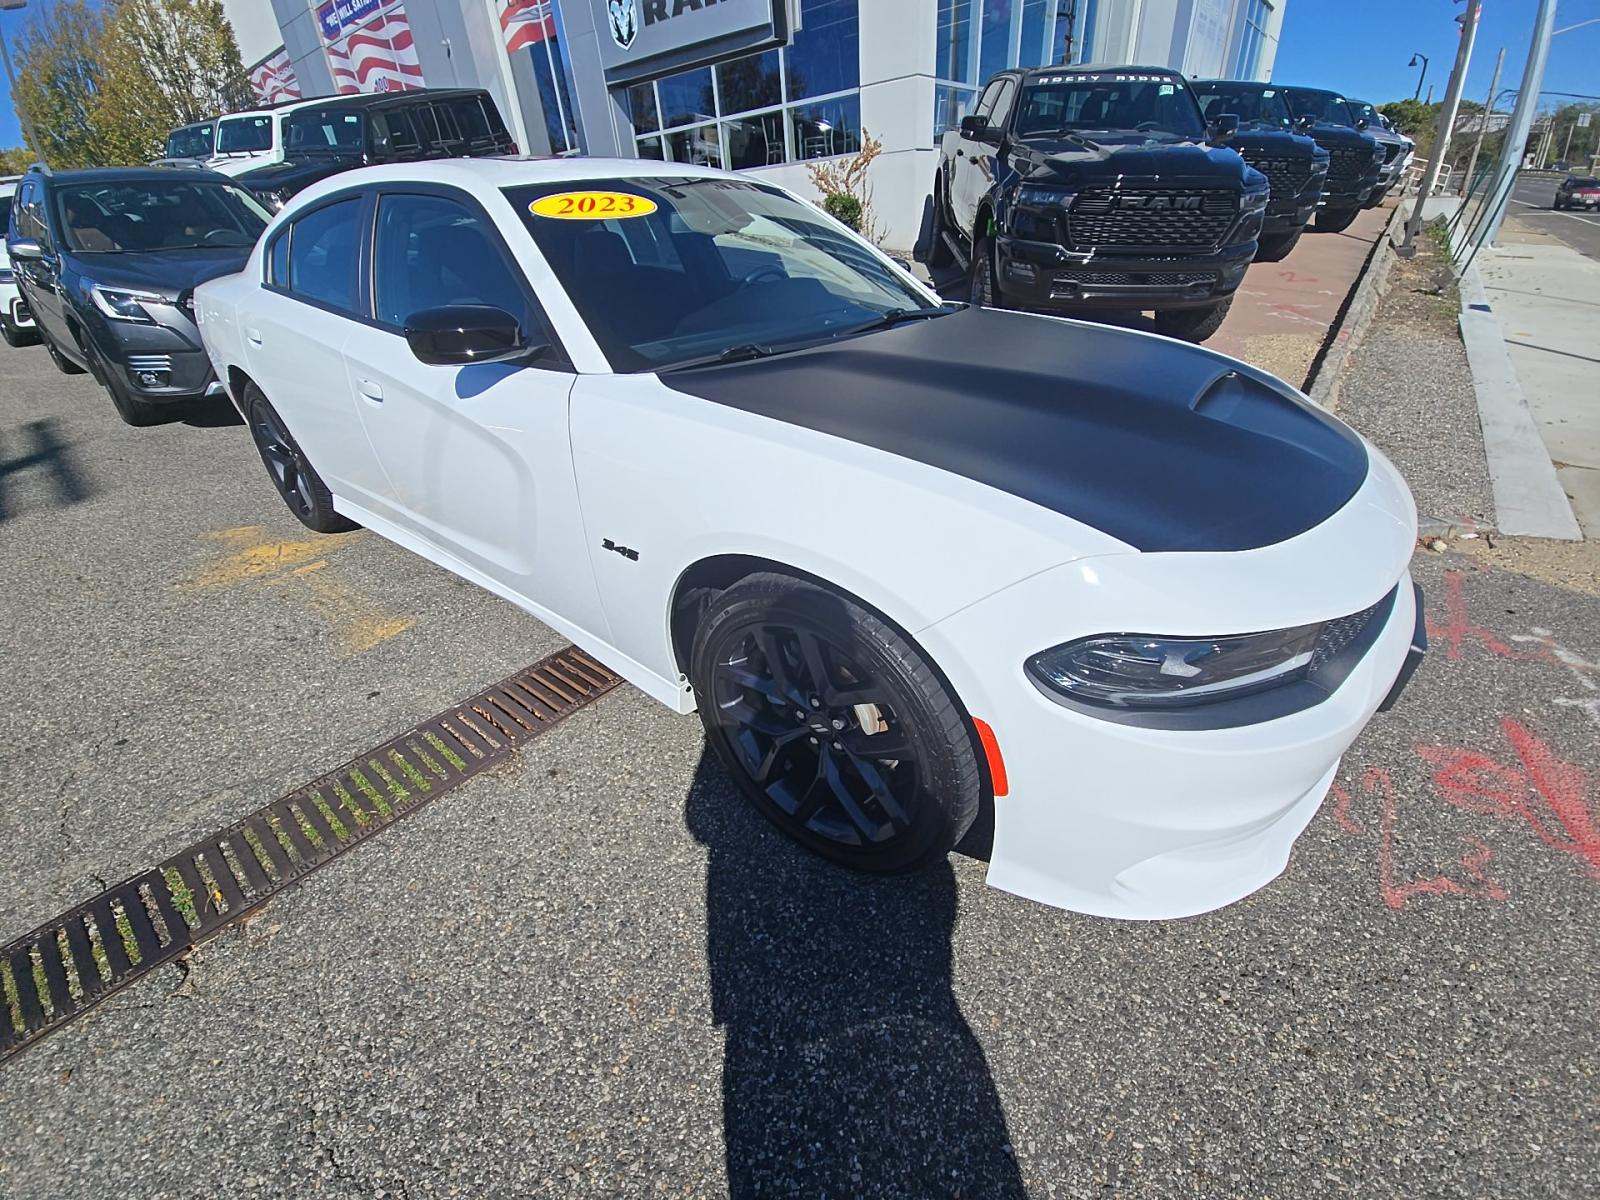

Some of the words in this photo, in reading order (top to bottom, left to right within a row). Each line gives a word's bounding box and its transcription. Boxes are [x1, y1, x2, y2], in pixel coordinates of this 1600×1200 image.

[642, 0, 727, 26] RA
[1039, 75, 1100, 85] ROCKY
[557, 196, 636, 215] 2023
[1119, 195, 1202, 209] RAM
[601, 537, 640, 562] 345
